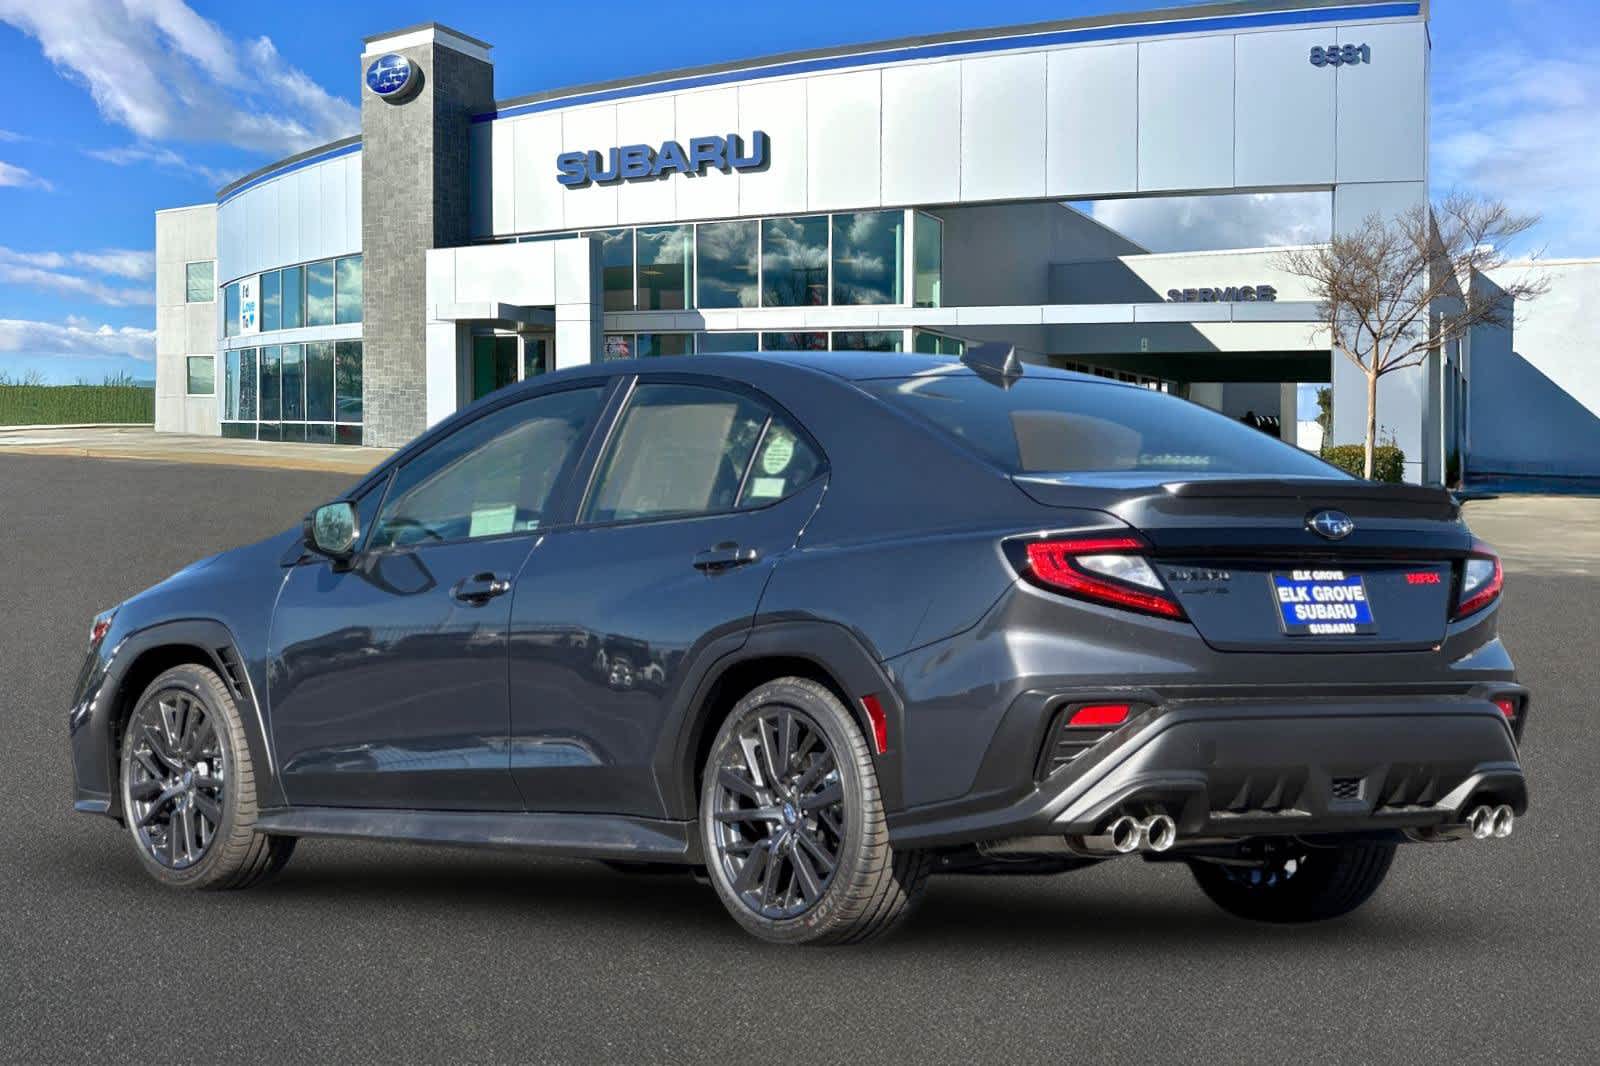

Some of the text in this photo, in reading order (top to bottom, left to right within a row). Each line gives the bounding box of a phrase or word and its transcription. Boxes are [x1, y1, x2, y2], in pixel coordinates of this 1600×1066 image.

[556, 130, 770, 190] SUBARU
[1167, 285, 1277, 302] SERVICE
[1292, 570, 1345, 581] ELK GROVE
[1277, 585, 1365, 602] ELK GROVE
[1294, 604, 1357, 620] SUBARU
[1308, 623, 1356, 635] SUBARU
